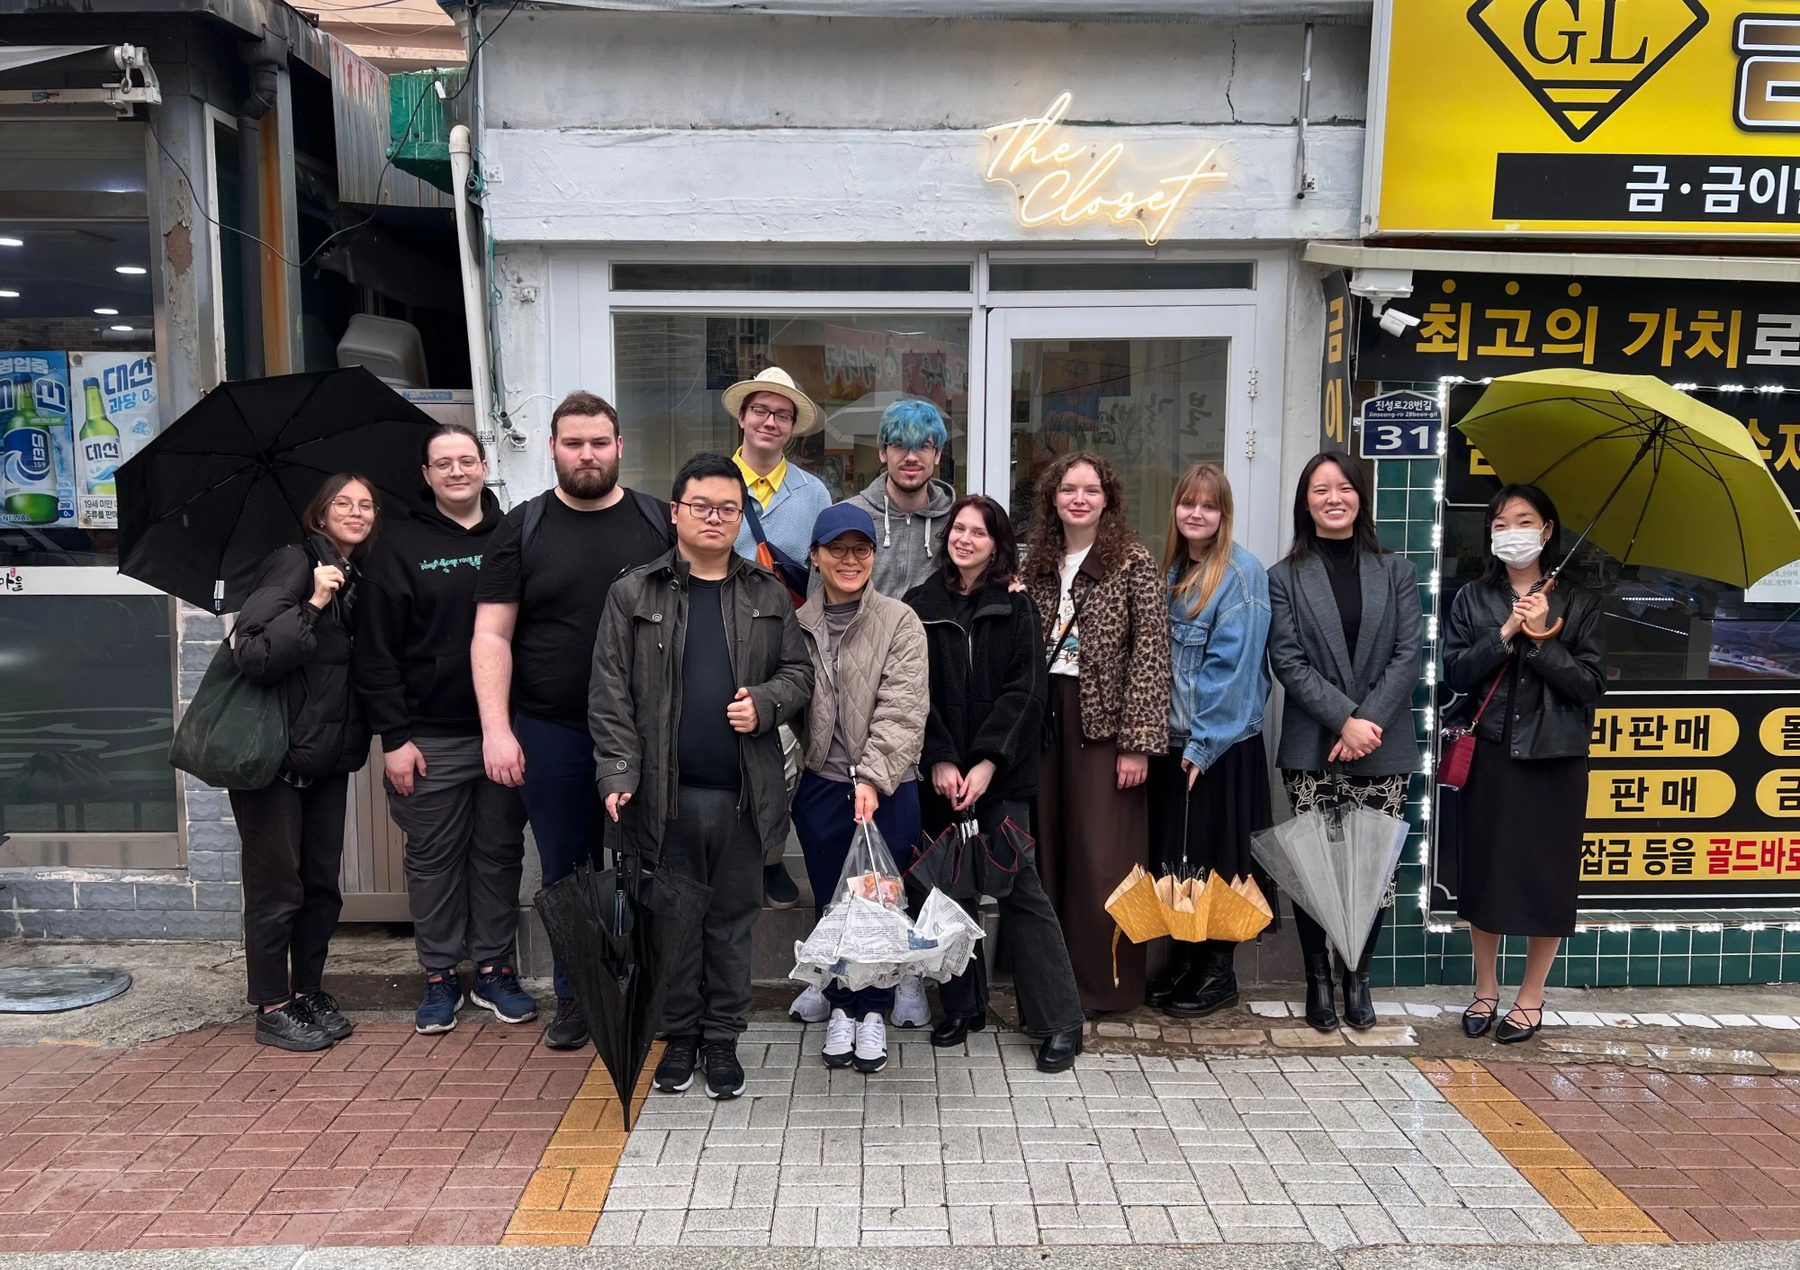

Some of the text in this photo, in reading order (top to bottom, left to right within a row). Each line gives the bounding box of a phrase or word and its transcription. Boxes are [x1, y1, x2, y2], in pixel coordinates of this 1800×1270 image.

[1523, 0, 1649, 65] GL
[986, 92, 1087, 178] The
[1021, 143, 1228, 242] Closet
[1626, 165, 1800, 214] 금·금이
[1416, 302, 1599, 364] 최고의
[104, 357, 153, 396] 대선
[109, 391, 138, 414] 과당
[1375, 400, 1432, 412] 진성로28번길
[85, 442, 119, 461] 대선
[1375, 426, 1429, 450] 31
[99, 500, 113, 509] 미만
[1643, 838, 1696, 875] 등을
